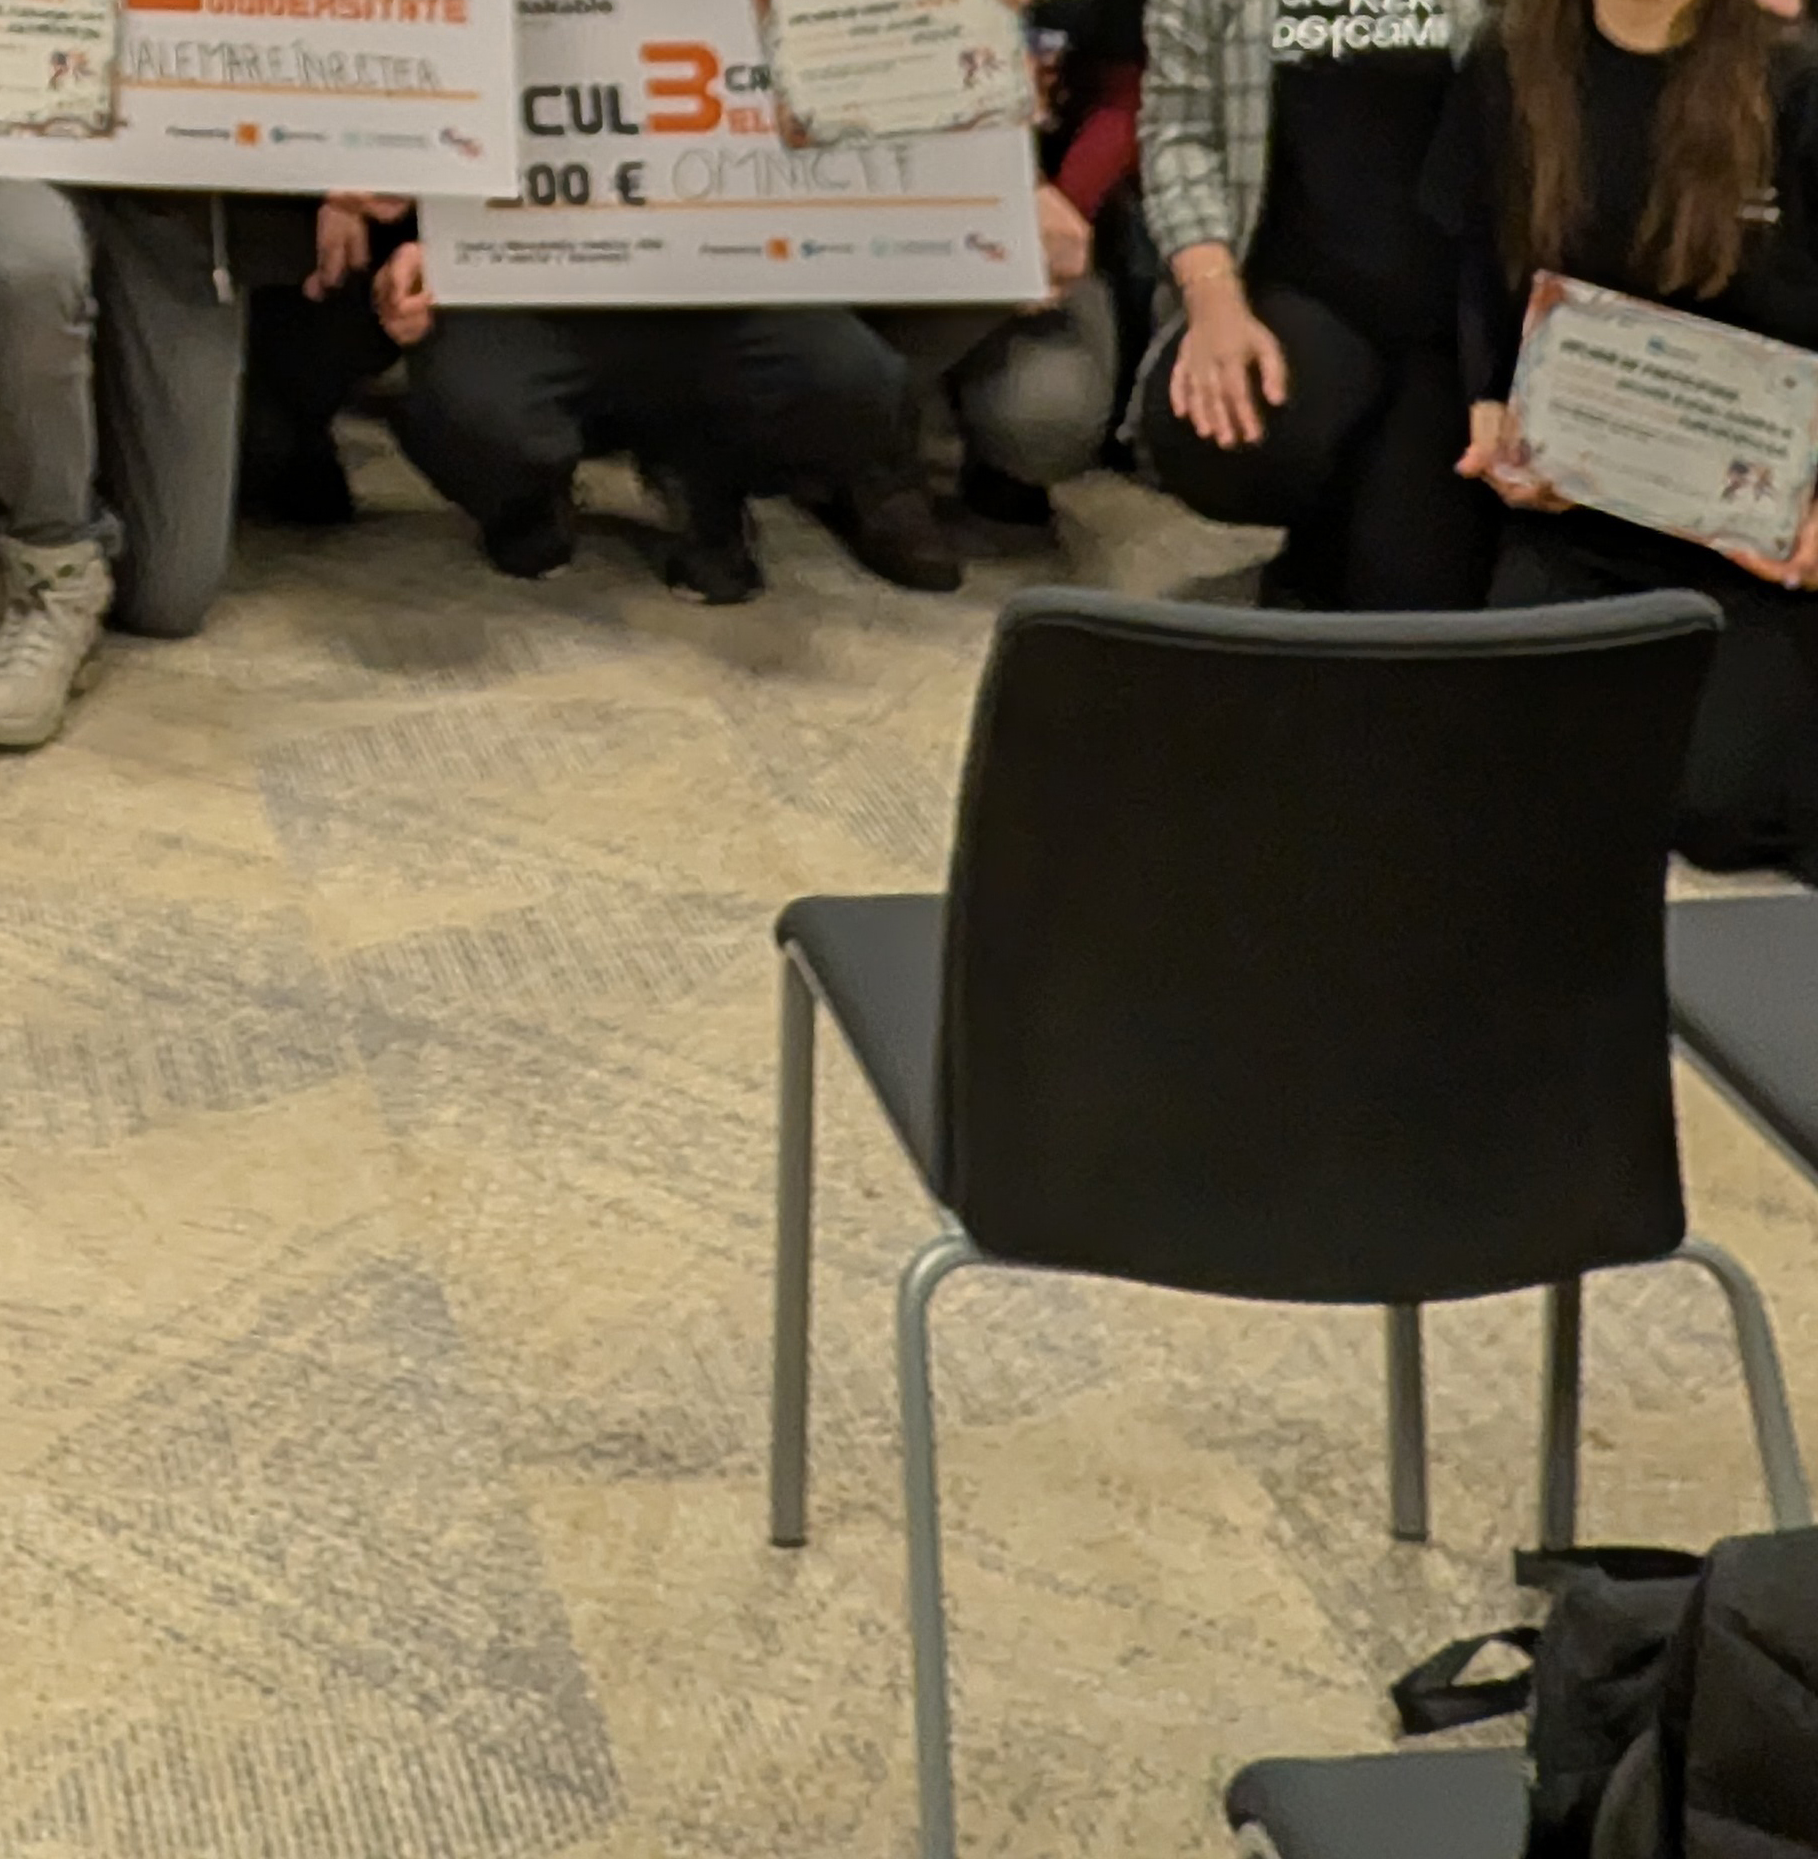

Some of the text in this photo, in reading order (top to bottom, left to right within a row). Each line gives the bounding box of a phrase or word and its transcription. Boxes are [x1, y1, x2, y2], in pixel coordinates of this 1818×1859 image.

[523, 83, 640, 137] CUL
[638, 42, 723, 135] 3
[616, 161, 648, 207] €
